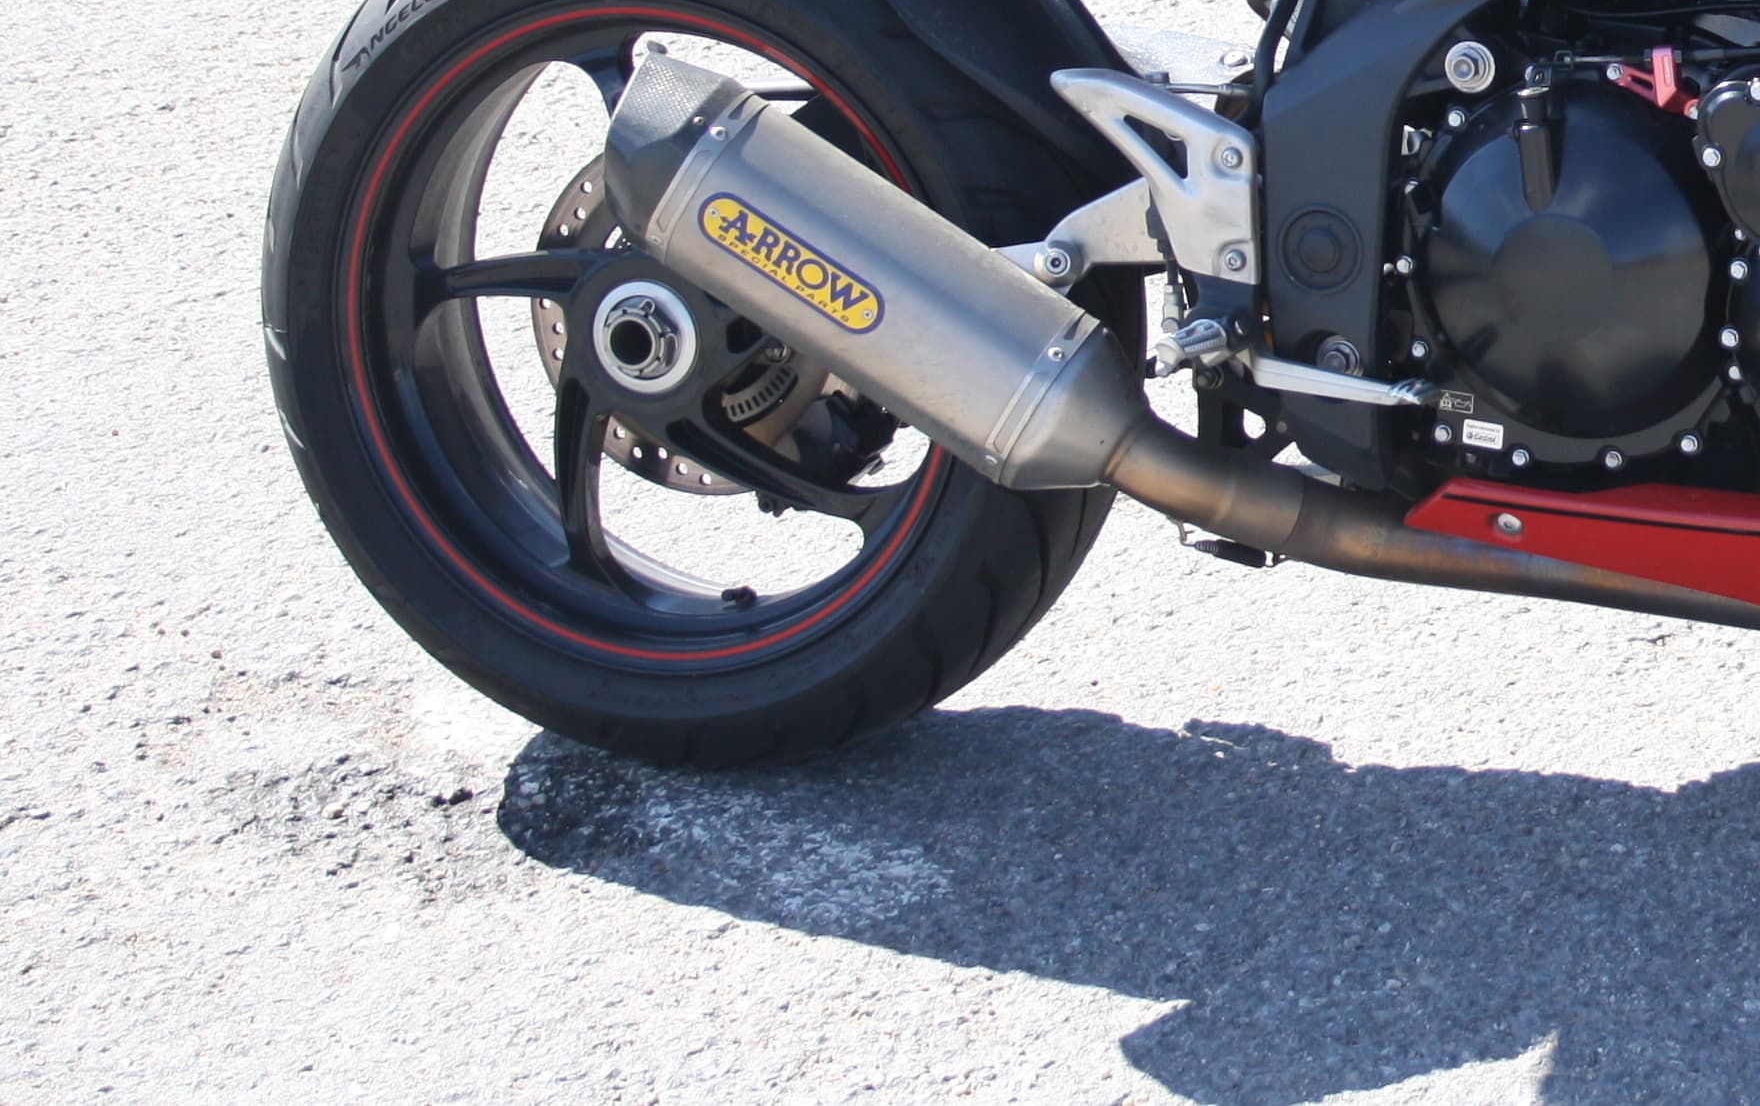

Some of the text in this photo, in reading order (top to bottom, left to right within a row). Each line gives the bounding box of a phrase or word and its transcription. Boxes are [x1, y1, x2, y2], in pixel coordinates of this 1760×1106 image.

[717, 234, 850, 323] SPECIAL PARTS
[719, 209, 869, 312] ARROW
